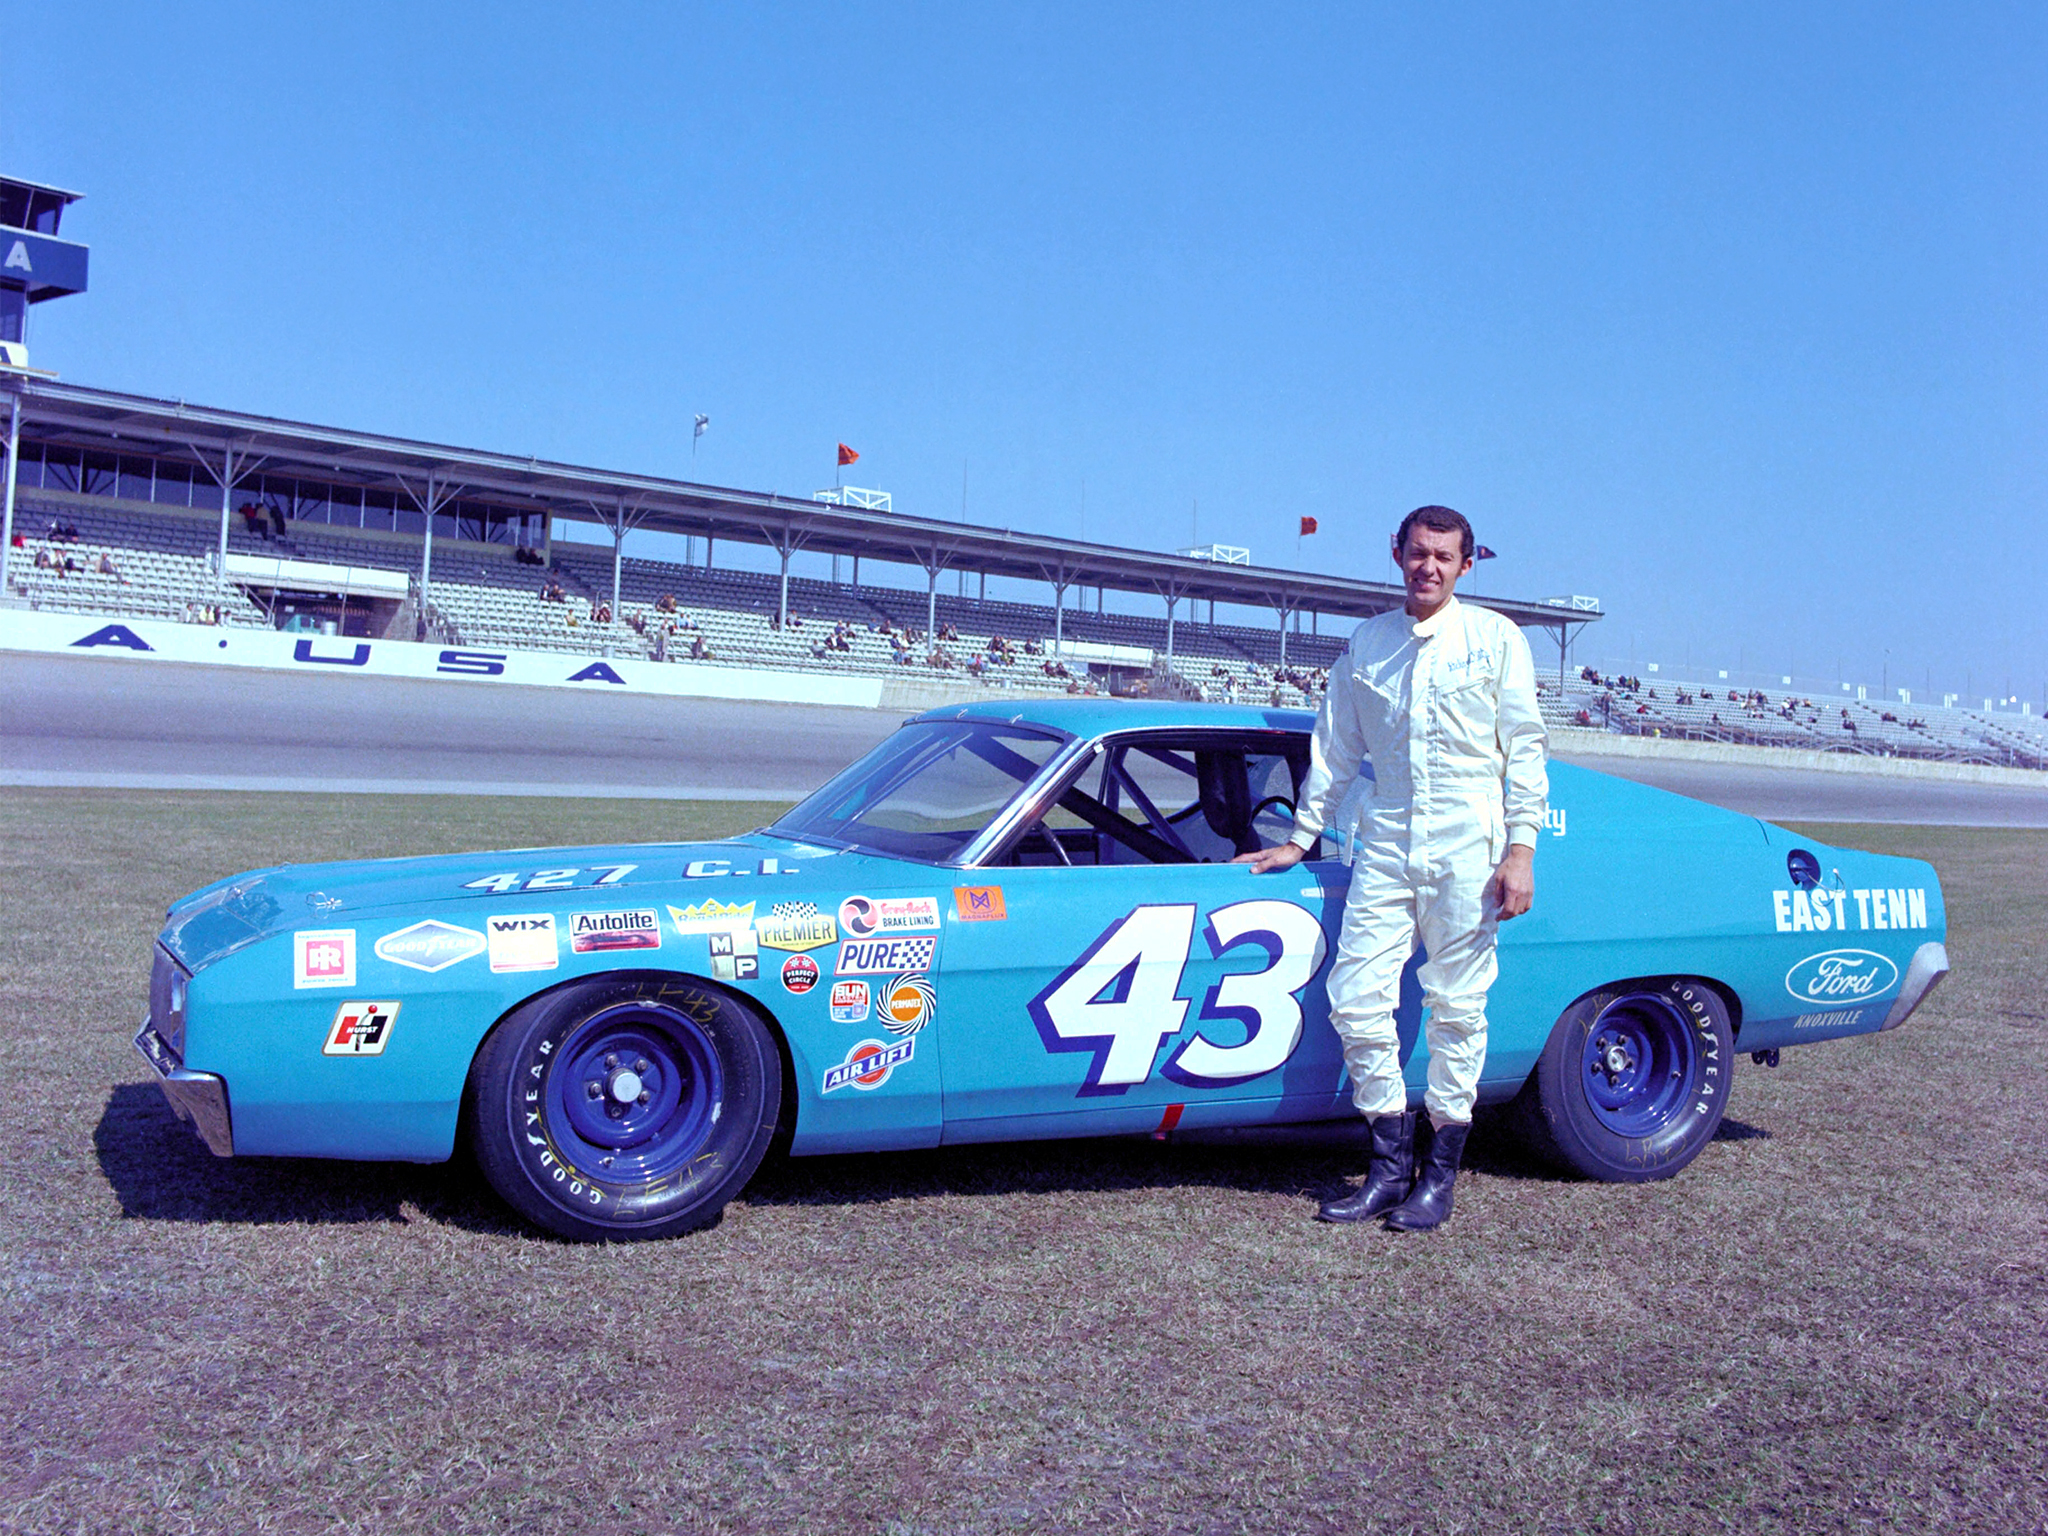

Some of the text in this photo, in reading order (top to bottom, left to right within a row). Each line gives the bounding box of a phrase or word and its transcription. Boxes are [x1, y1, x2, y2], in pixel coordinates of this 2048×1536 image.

[4, 240, 33, 272] A
[68, 623, 628, 685] A USA
[459, 858, 800, 893] 427 C.I.
[577, 912, 653, 931] Autolite
[883, 915, 934, 928] BRAKE LINING
[1772, 888, 1928, 932] EAST TENN
[492, 920, 551, 932] WIX
[764, 920, 832, 942] PREMIER
[841, 943, 902, 971] PURE
[786, 969, 816, 978] PERFECT
[788, 977, 812, 985] CIRCLE
[1808, 957, 1879, 996] Ford
[1026, 898, 1329, 1098] 43
[346, 1025, 379, 1034] HURST
[1794, 1010, 1863, 1028] KNOXVILLE
[1671, 981, 1719, 1115] GOODYEAR
[828, 1043, 910, 1087] AIR LIFT
[526, 1040, 602, 1205] GOODYEAR
